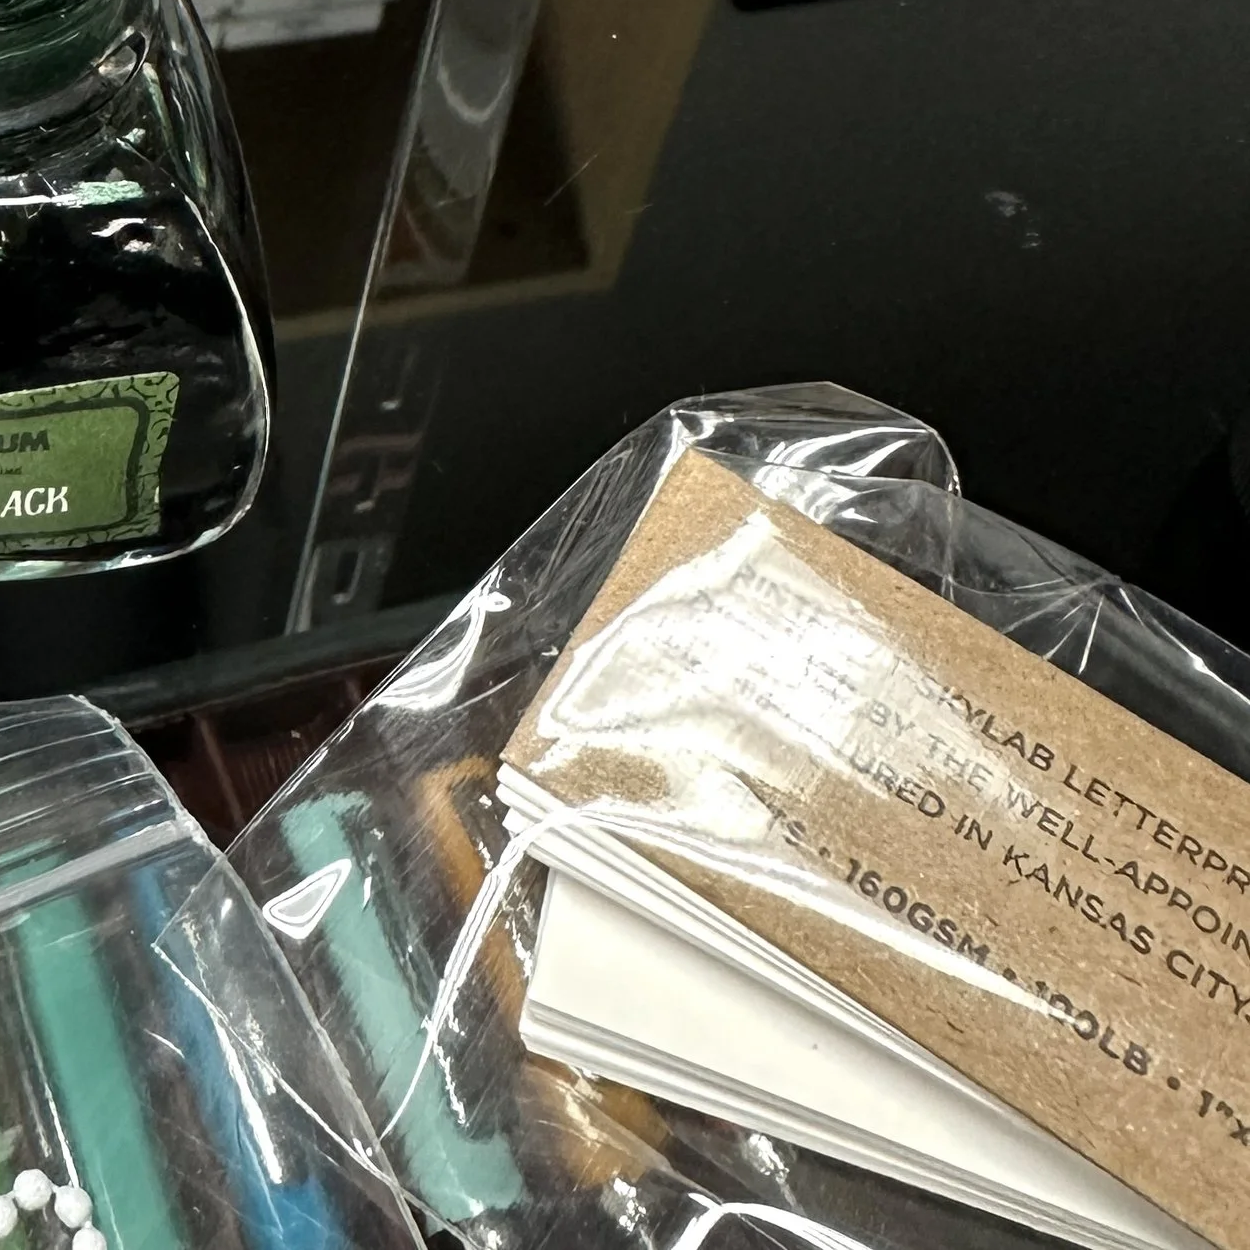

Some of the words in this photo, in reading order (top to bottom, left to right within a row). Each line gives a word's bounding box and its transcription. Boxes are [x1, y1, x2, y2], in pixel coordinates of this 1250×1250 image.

[868, 700, 916, 737] BY
[927, 732, 995, 794] THE
[954, 813, 994, 851] IN
[1002, 845, 1156, 955] KANSAS
[845, 857, 992, 967] 160GSM
[1034, 979, 1153, 1077] 100LB
